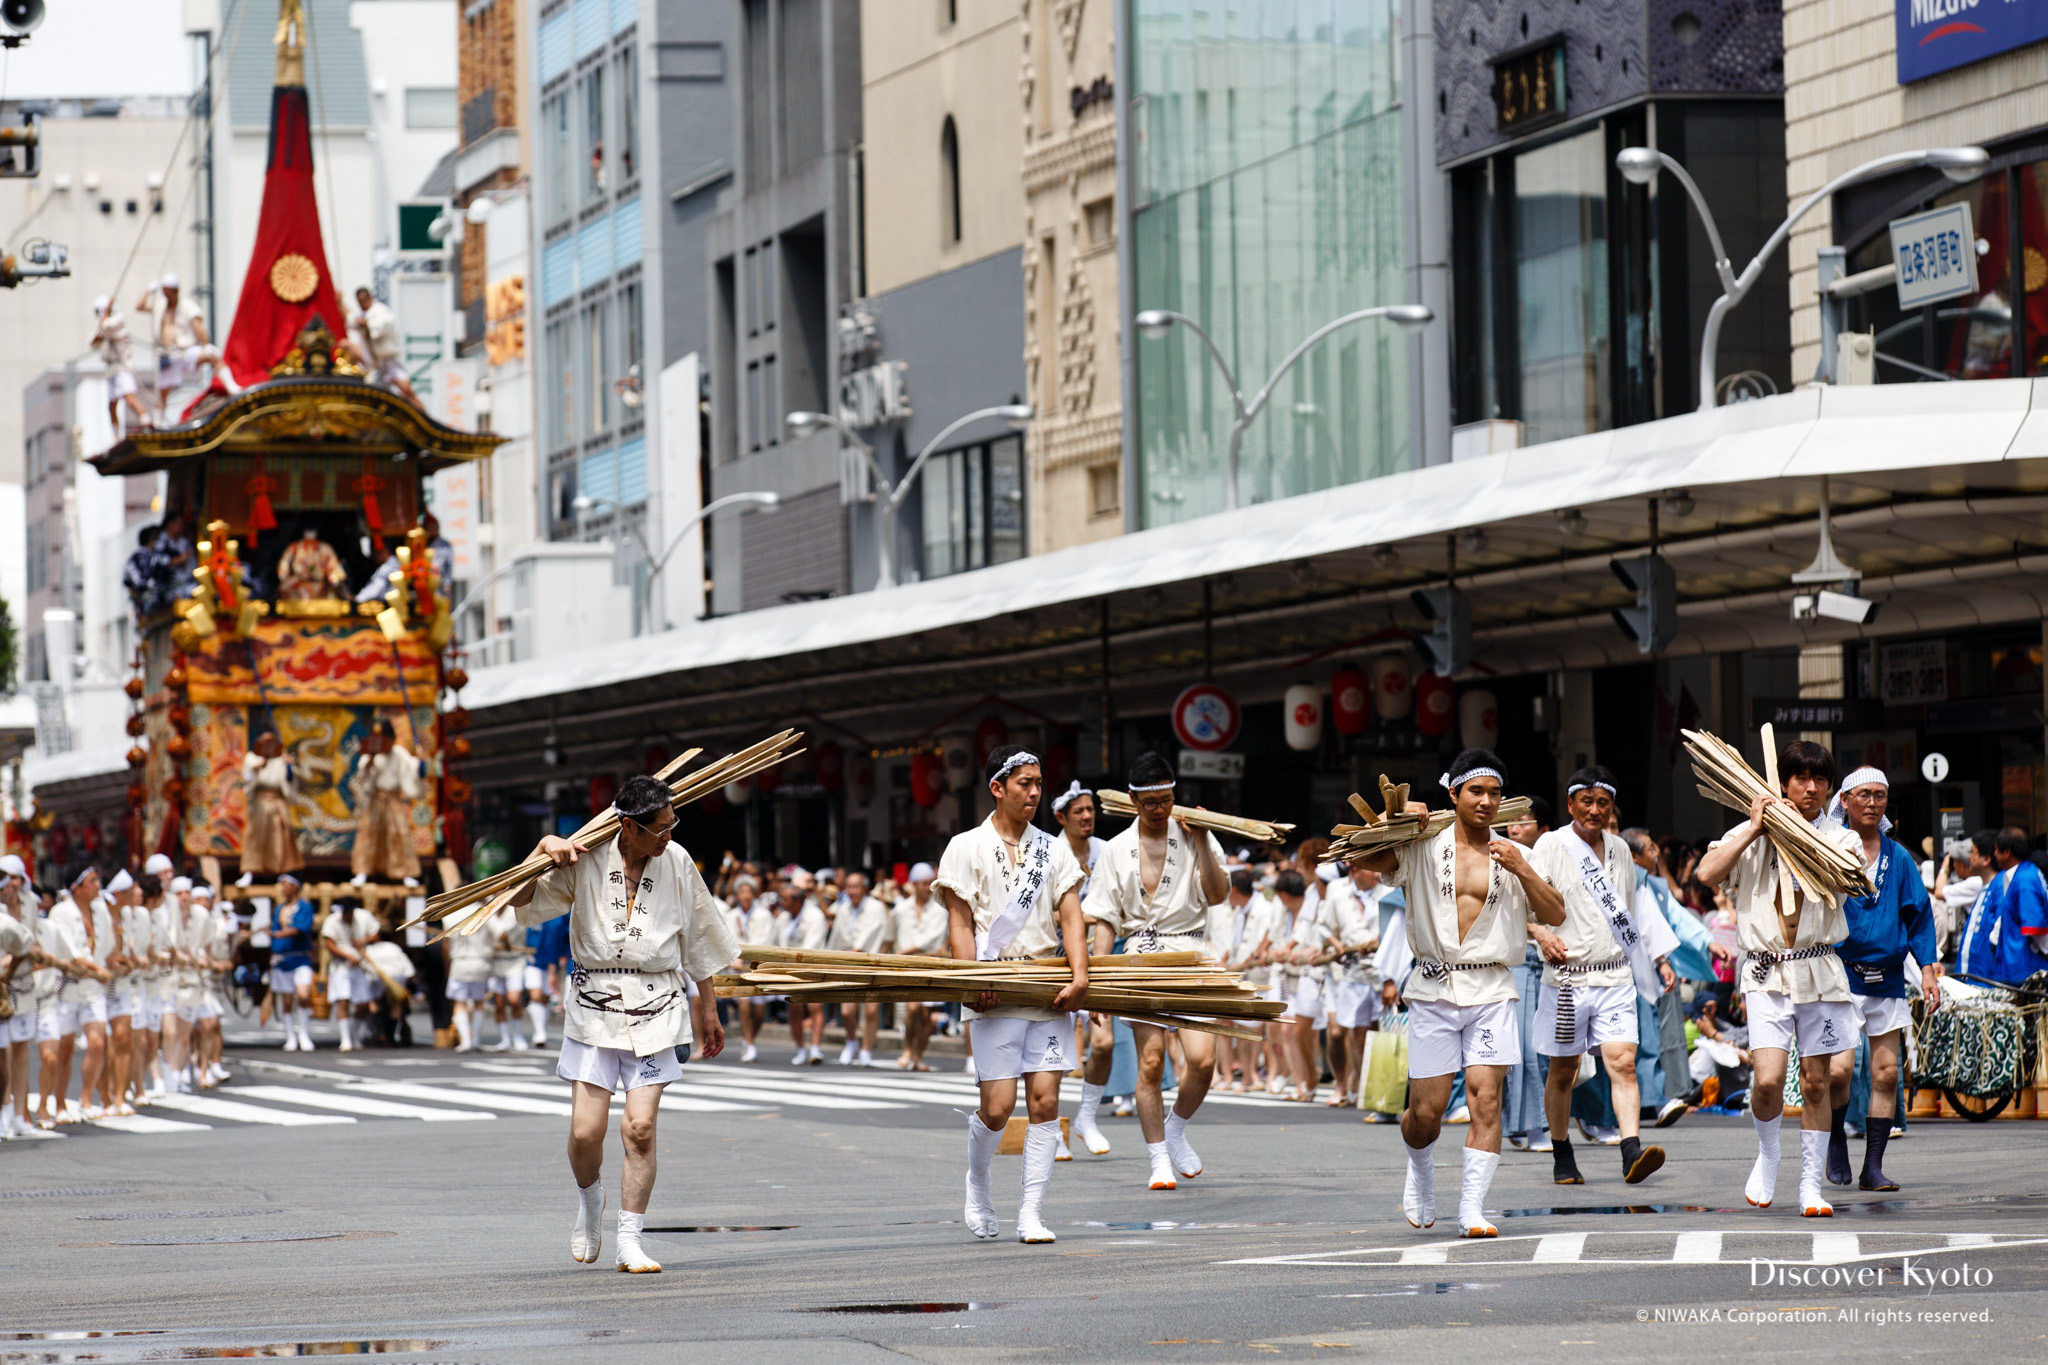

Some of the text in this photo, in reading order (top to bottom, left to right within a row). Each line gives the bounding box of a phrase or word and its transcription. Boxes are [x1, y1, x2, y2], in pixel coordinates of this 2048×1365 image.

[1900, 230, 1962, 285] 四条河原町
[1775, 707, 1844, 723] みずほ銀行
[609, 870, 627, 933] 菊水鉾
[629, 877, 654, 941] 菊水鉾
[1580, 856, 1638, 947] 巡行警備係
